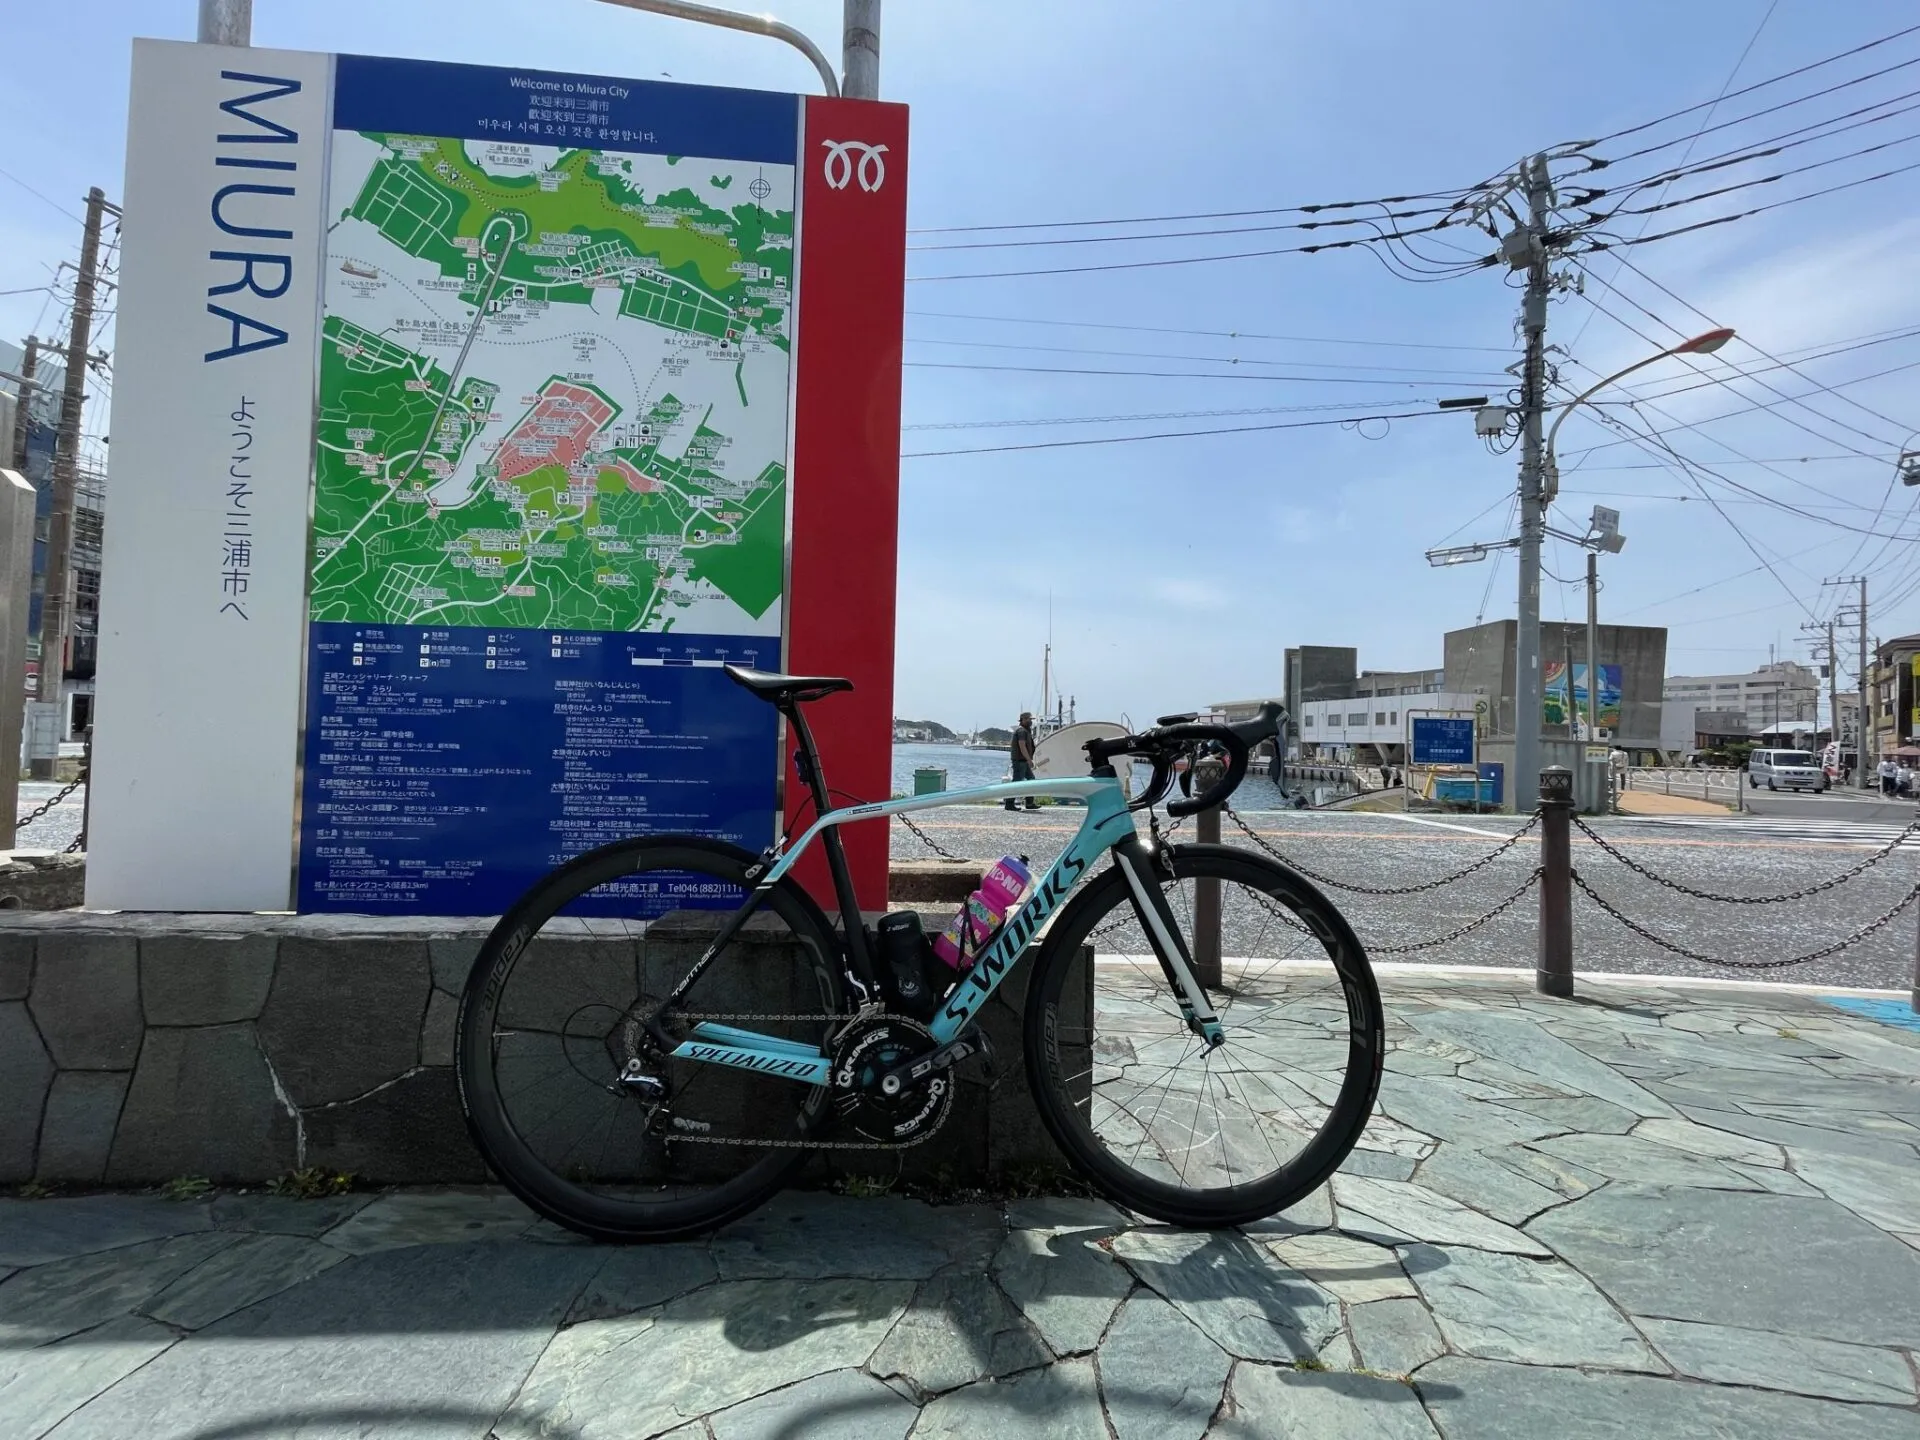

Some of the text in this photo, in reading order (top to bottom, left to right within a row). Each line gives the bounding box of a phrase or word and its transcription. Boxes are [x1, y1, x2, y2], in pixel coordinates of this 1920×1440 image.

[478, 118, 512, 132] 미우라
[517, 121, 539, 134] 시에
[543, 125, 566, 137] 오신
[572, 125, 594, 138] 것을
[510, 77, 629, 99] Welcome to Miura City
[204, 70, 302, 364] MIURA
[221, 394, 254, 621] ようこそ三浦市へ
[945, 845, 1085, 1036] S-WORKS
[689, 1045, 819, 1077] SPECIALIZED
